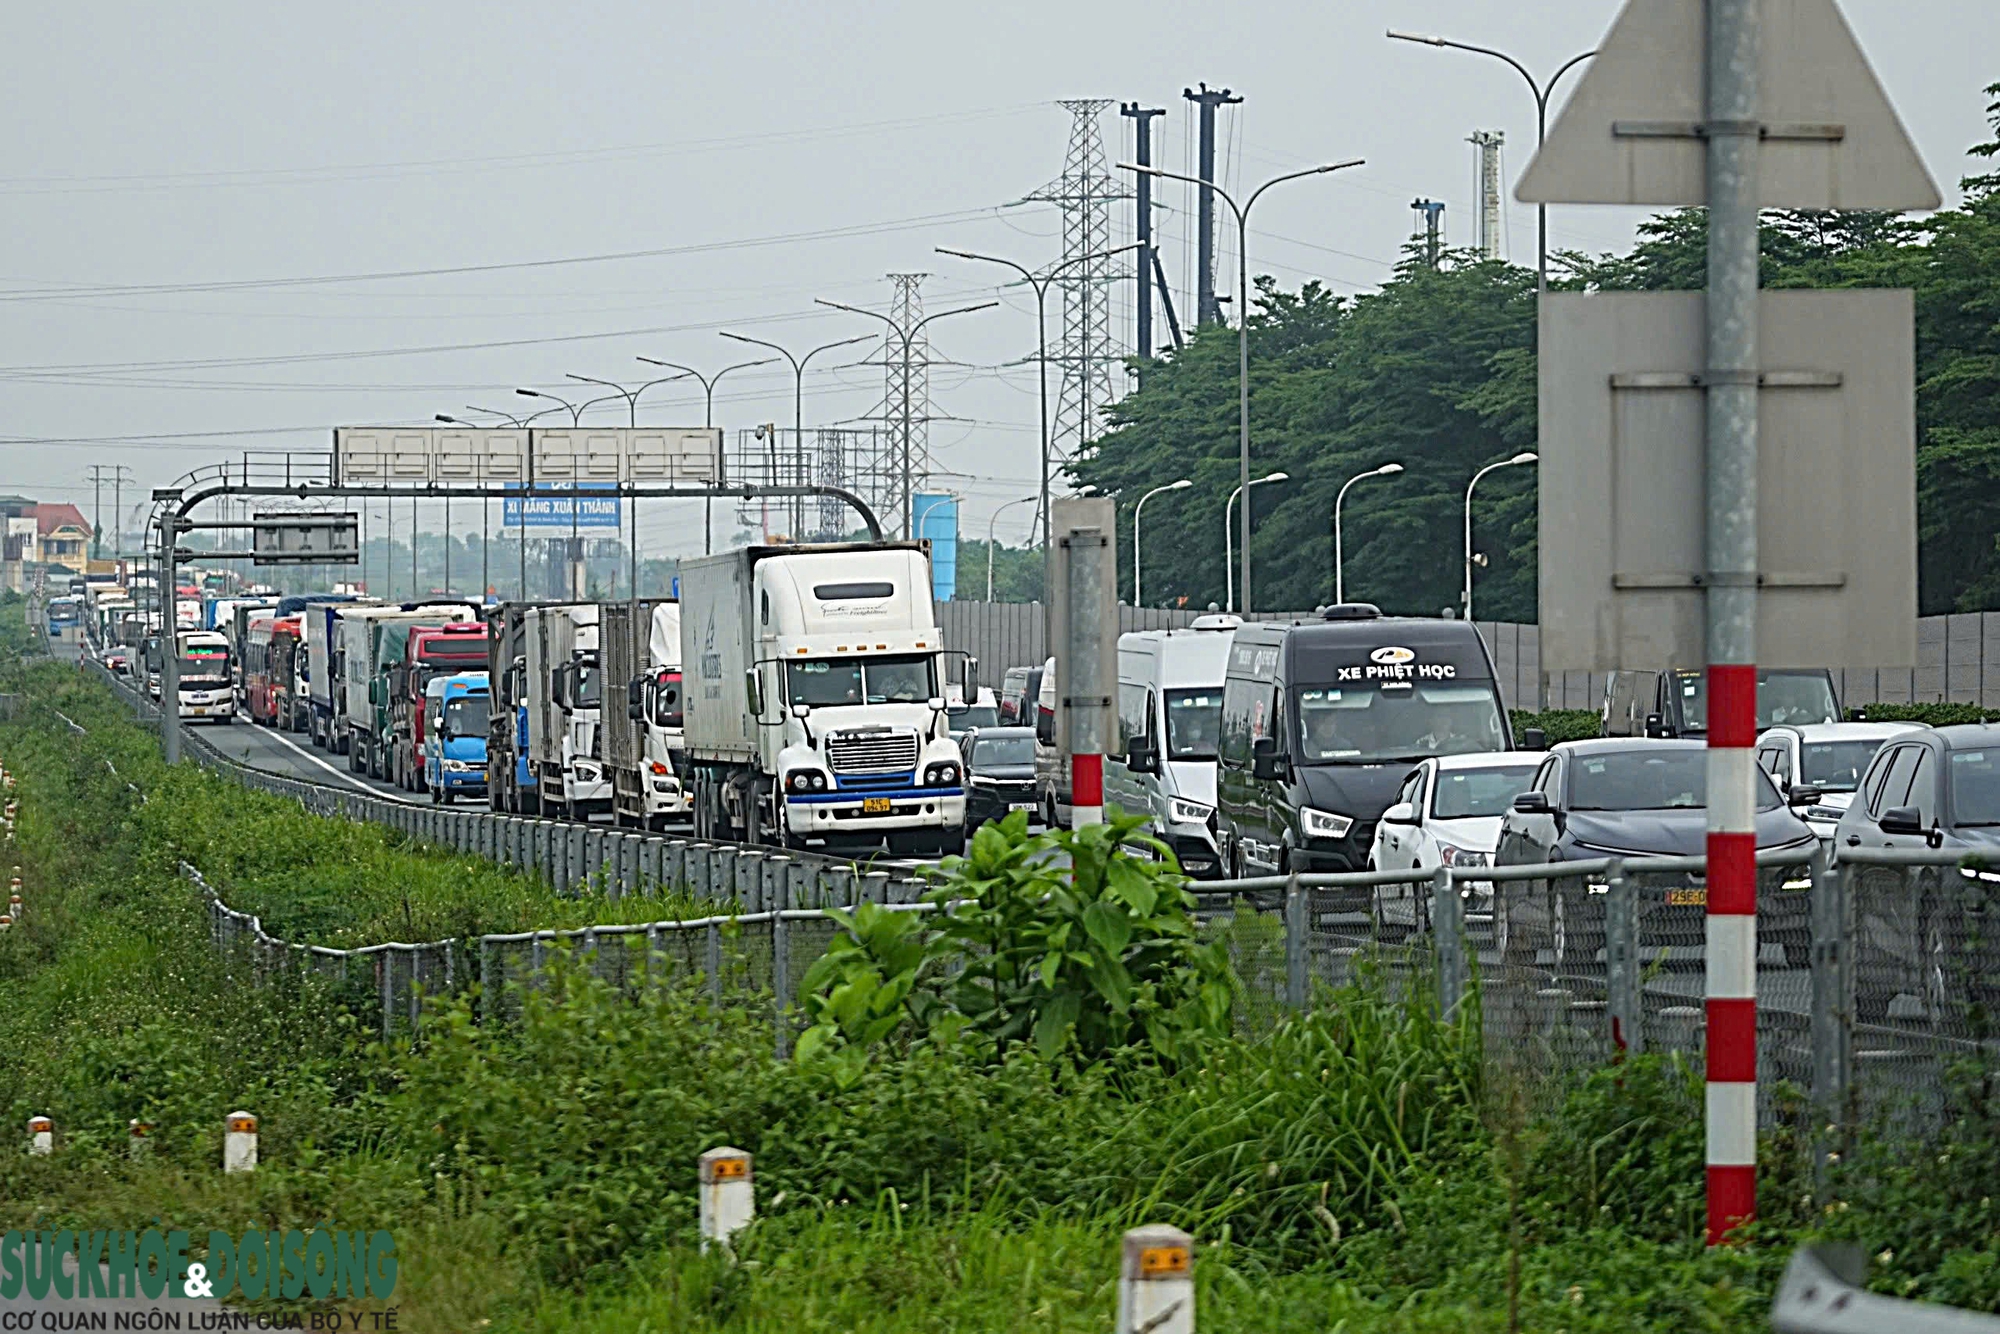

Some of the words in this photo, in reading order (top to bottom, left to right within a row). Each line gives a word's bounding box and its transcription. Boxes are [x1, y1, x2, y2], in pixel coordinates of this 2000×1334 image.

[507, 501, 518, 513] XI
[582, 498, 616, 514] THÀNH
[1338, 666, 1362, 681] XE
[1365, 662, 1415, 680] PHIỆT
[1418, 664, 1456, 680] HỌC
